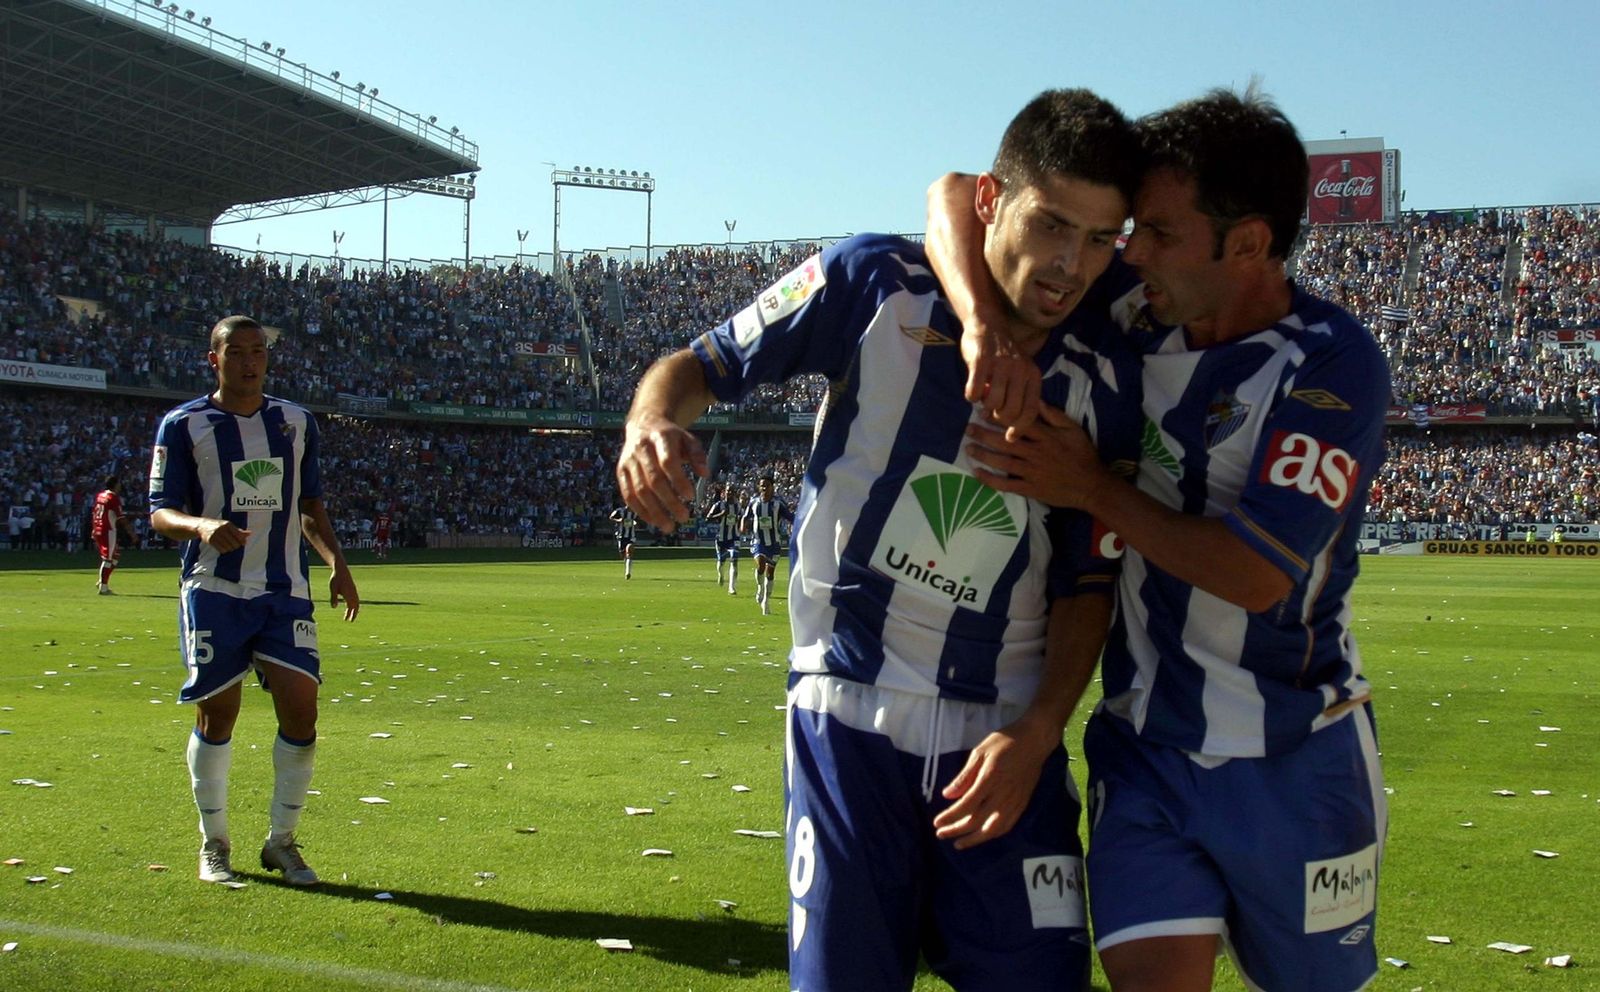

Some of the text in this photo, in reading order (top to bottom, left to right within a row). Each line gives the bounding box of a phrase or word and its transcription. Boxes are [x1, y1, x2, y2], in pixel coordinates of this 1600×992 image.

[1537, 330, 1597, 342] as as
[515, 341, 566, 355] as as
[0, 364, 36, 379] YOTA
[1269, 432, 1358, 508] as
[236, 495, 278, 508] Unicaja
[1360, 523, 1401, 539] PRE
[1555, 525, 1590, 533] ONO
[1427, 542, 1598, 556] GRUAS SANCHO TORO
[885, 546, 978, 604] Unicaja
[789, 816, 815, 898] 8
[1312, 864, 1373, 904] Málaga
